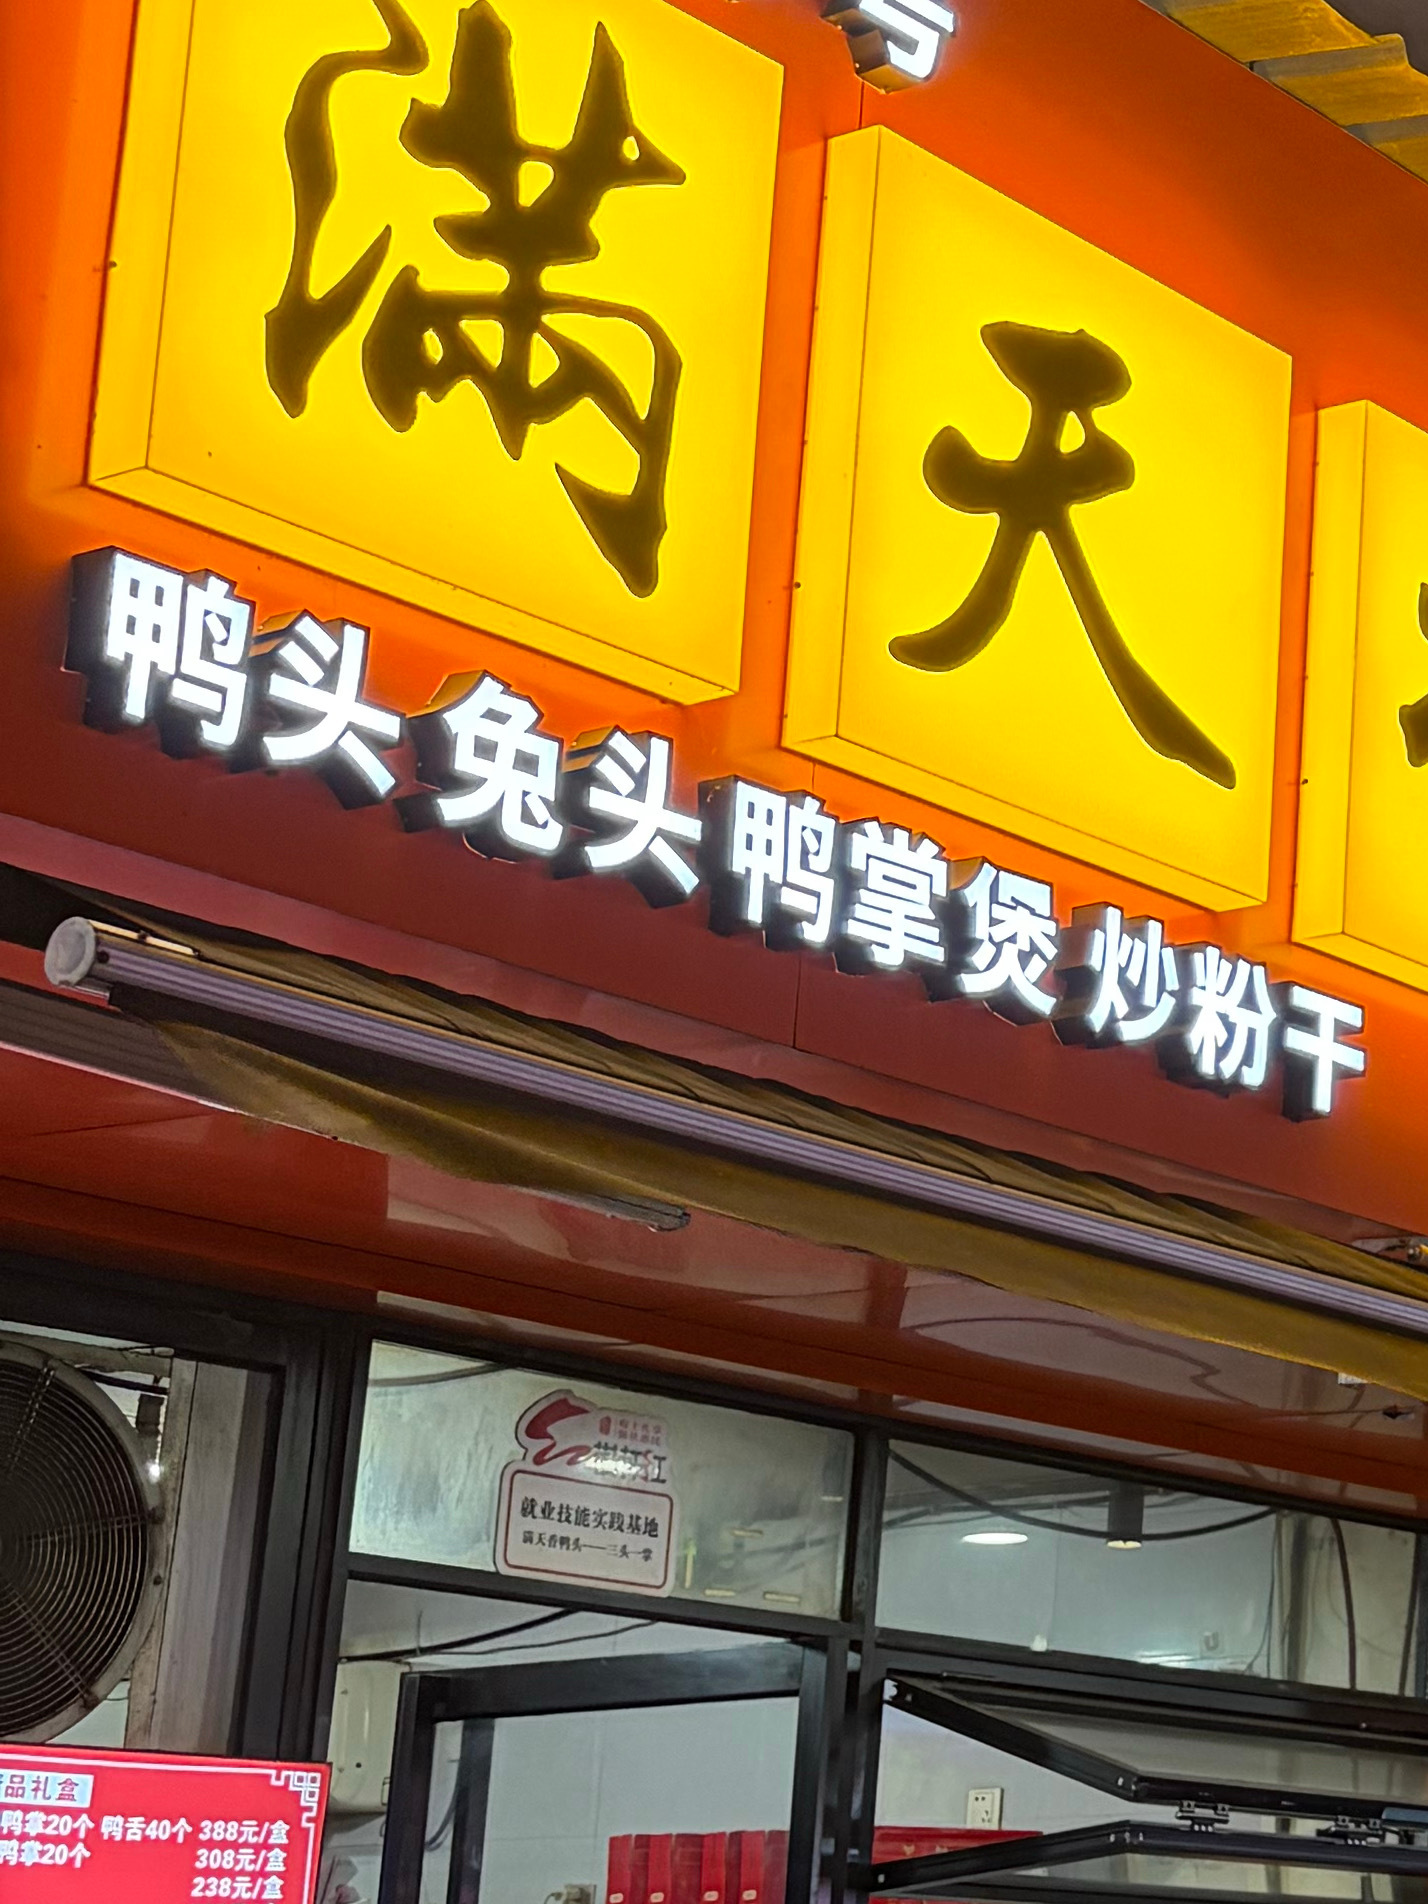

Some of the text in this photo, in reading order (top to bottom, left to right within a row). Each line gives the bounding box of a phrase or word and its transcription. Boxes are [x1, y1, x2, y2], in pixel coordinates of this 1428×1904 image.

[103, 551, 1368, 1115] 鸭头 兔头 鸭掌煲 炒粉干
[520, 1496, 660, 1539] 就业技能实践基地
[0, 1773, 80, 1803] 品礼盒
[100, 1814, 193, 1844] 鸭舌40个
[198, 1819, 291, 1845] 388元/盒
[194, 1847, 287, 1873] 308元/盒
[190, 1875, 285, 1901] 238元/盒
